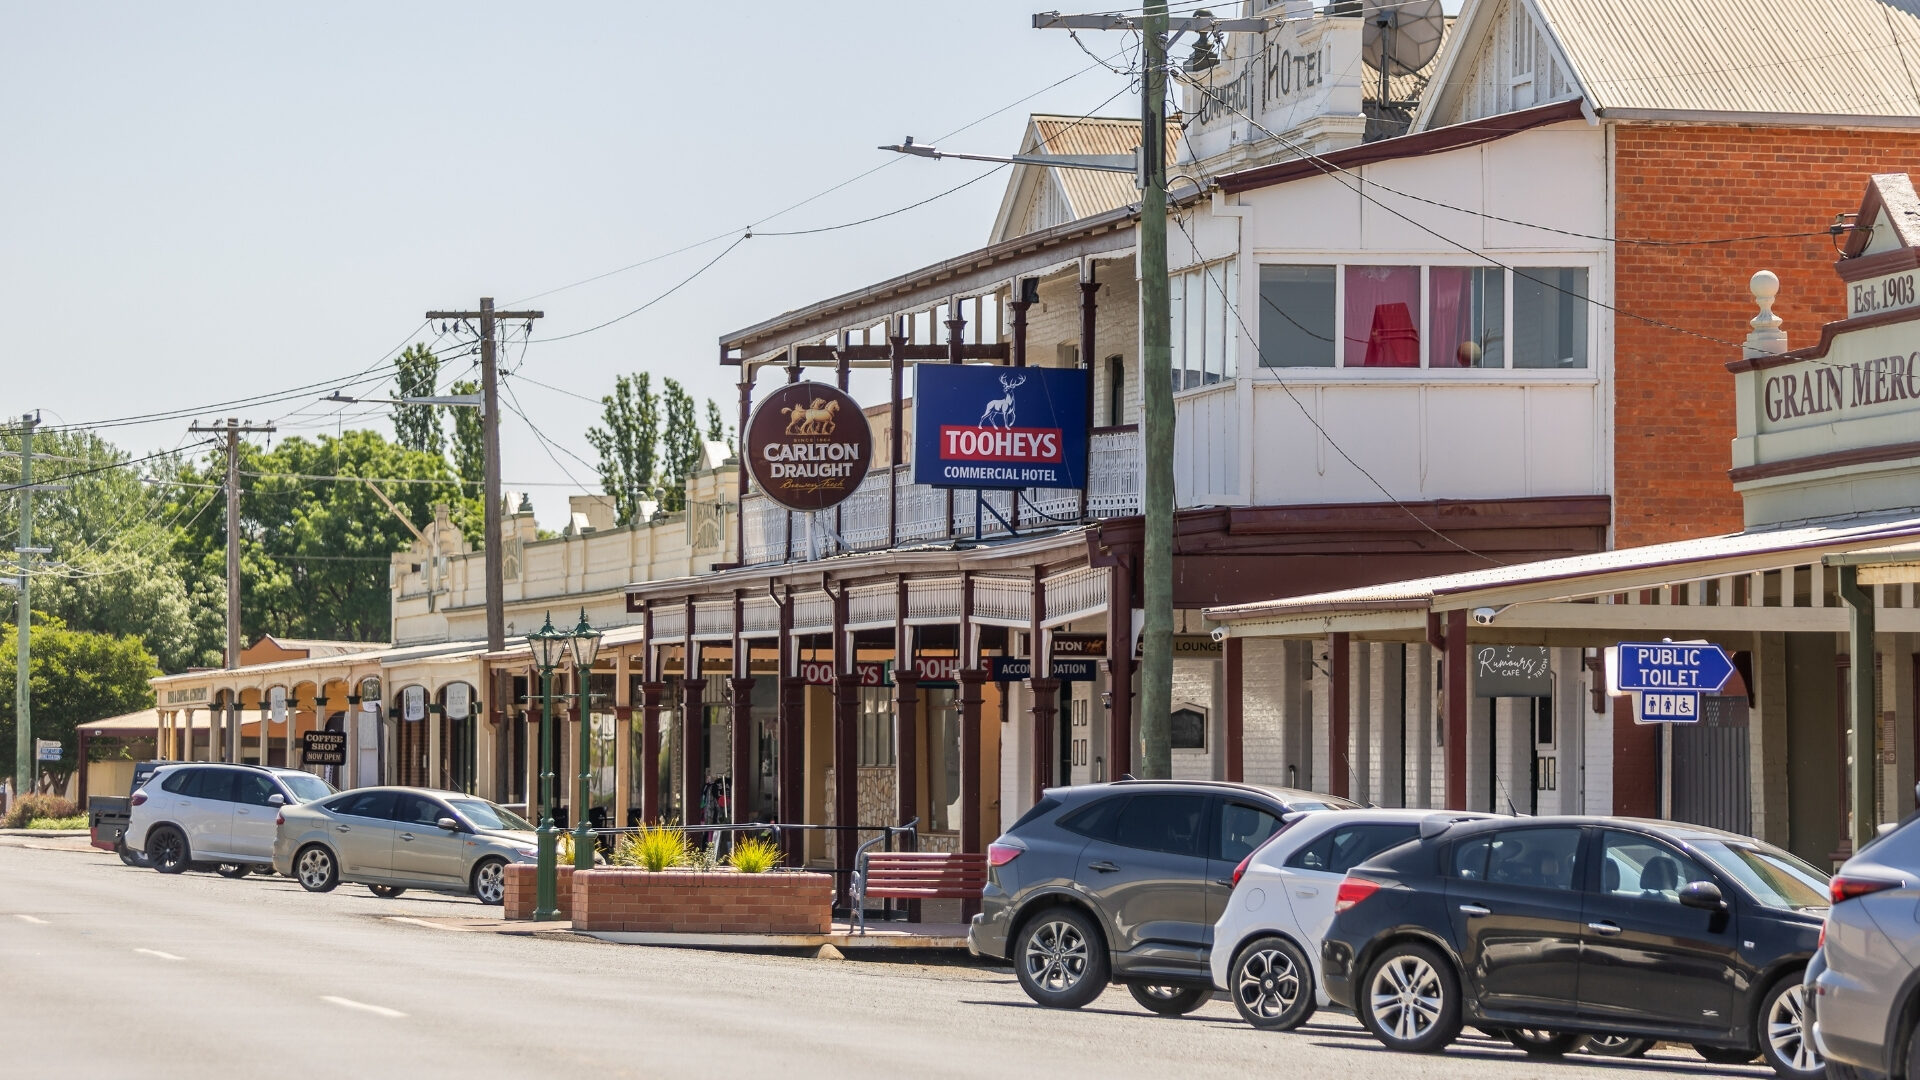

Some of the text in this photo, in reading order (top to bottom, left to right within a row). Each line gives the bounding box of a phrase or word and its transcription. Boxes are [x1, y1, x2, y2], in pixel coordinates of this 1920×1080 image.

[1267, 40, 1323, 101] HOTEL
[1200, 60, 1249, 126] COMMERCI
[1765, 351, 1920, 422] GRAIN MERC
[763, 442, 860, 462] CARLTON
[946, 430, 1057, 458] TOOHEYS
[770, 462, 854, 478] DRAUGHT
[944, 466, 1057, 482] COMMERCIAL HOTEL
[1053, 640, 1083, 652] LTON
[1175, 641, 1223, 652] LOUNGE
[1478, 647, 1537, 678] Rumours
[1638, 649, 1700, 666] PUBLIC
[800, 663, 879, 684] TOOYS
[1002, 663, 1087, 675] ACCODATION
[1533, 658, 1548, 678] HOTEL
[1639, 669, 1700, 686] TOILET
[306, 734, 344, 744] COFFEE
[311, 743, 338, 751] SHOP
[308, 752, 341, 761] NOW OPEN
